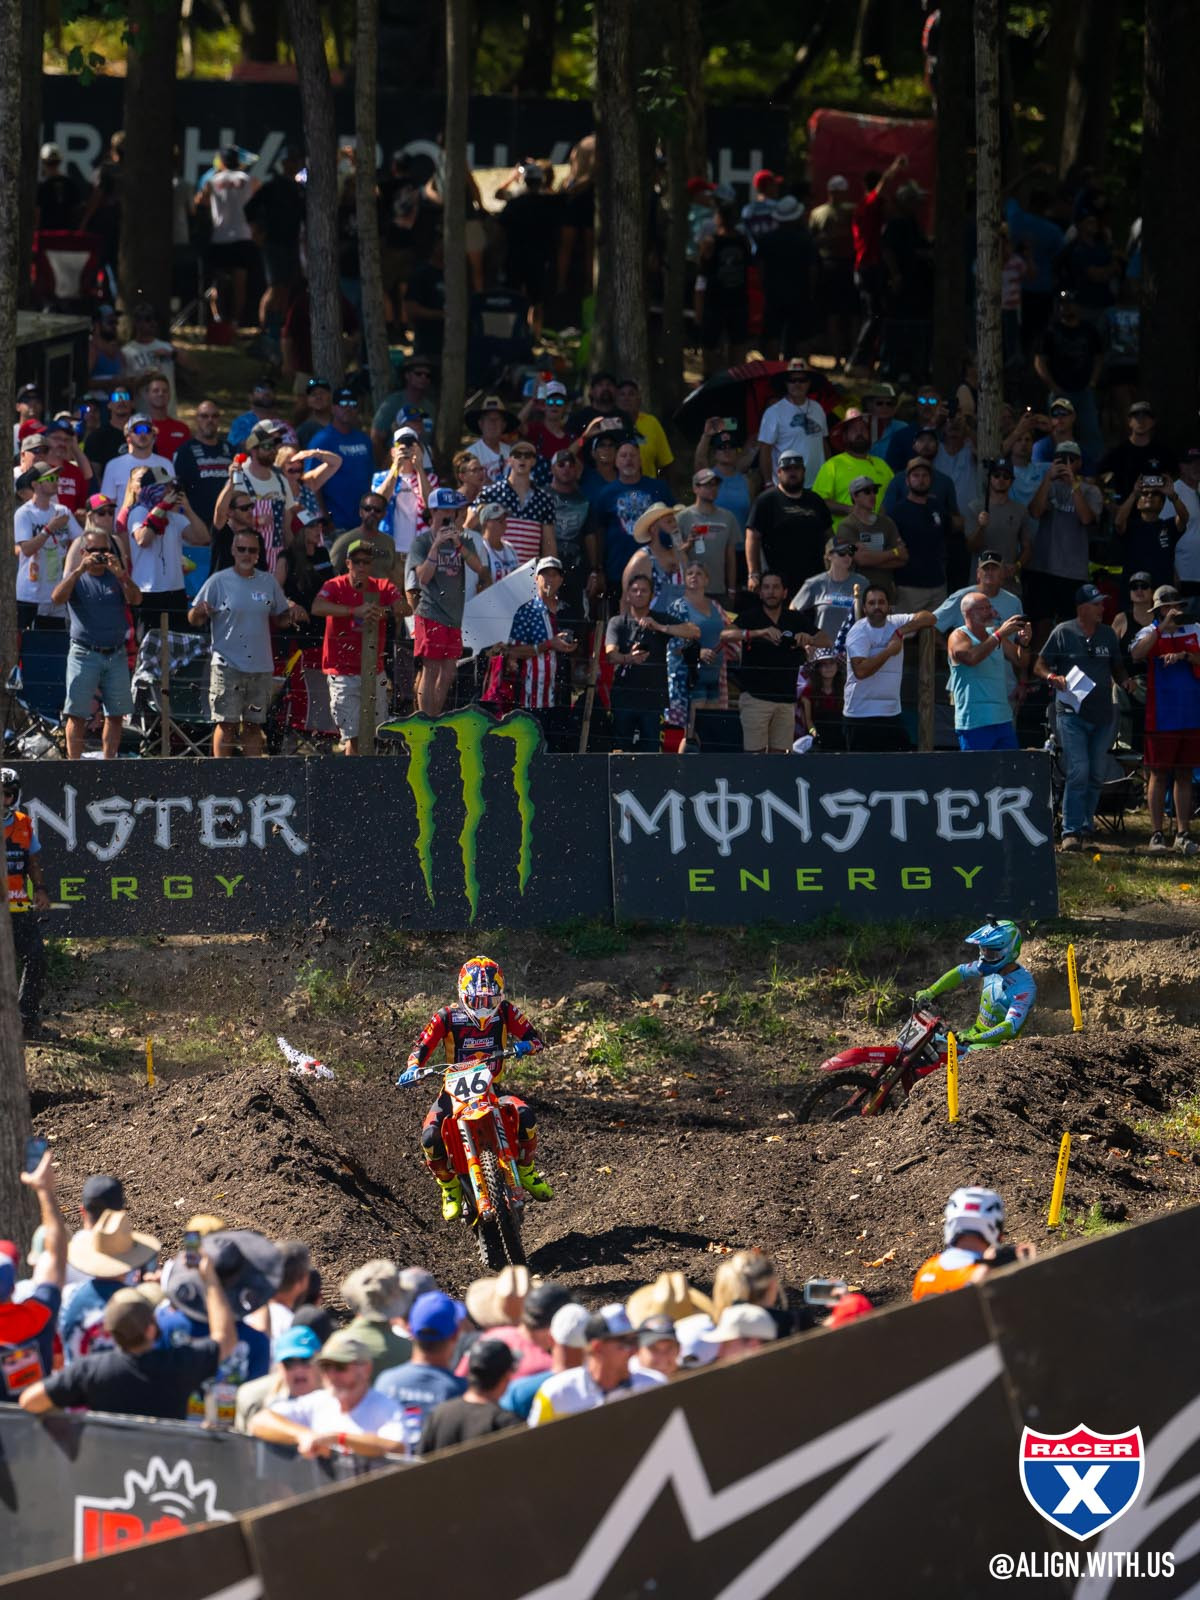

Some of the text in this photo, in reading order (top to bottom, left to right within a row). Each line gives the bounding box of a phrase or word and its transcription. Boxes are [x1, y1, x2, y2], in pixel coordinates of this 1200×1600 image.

[22, 784, 309, 863] NSTER
[613, 776, 1049, 857] MONSTER
[28, 874, 244, 901] ERGY
[688, 865, 985, 892] ENERGY
[454, 1071, 489, 1099] 46
